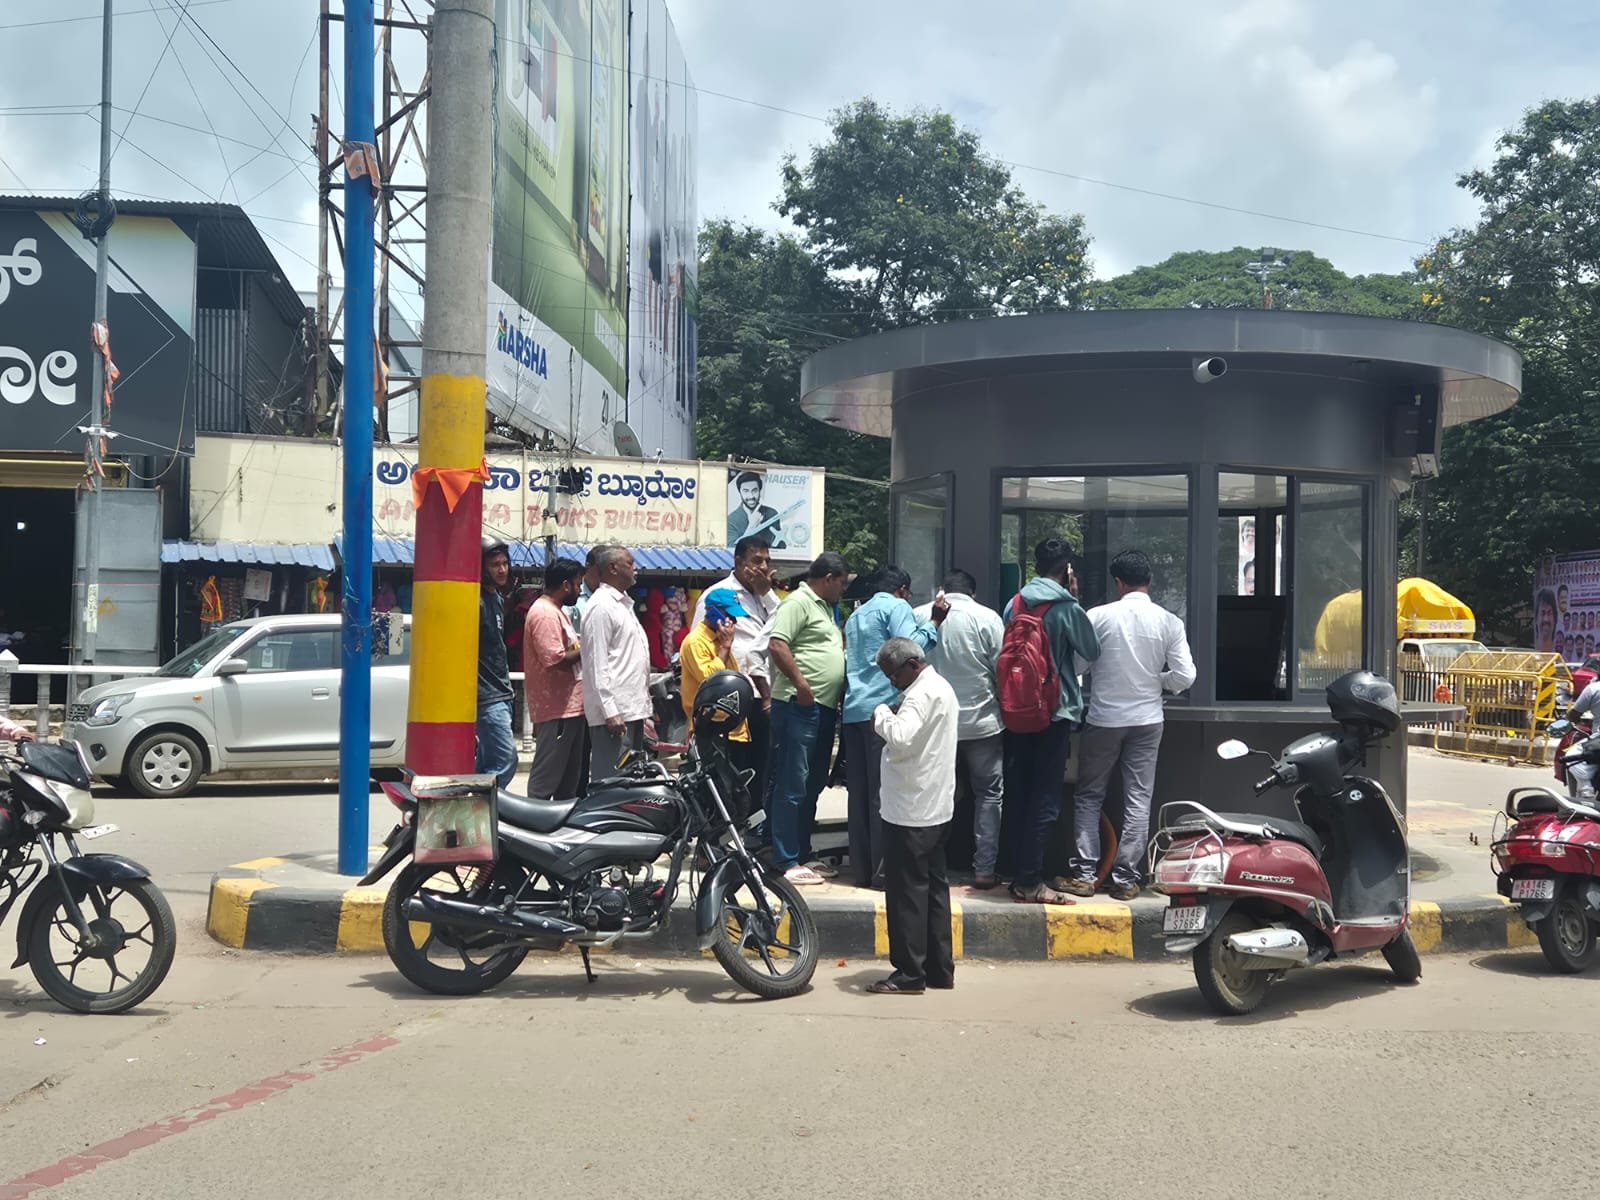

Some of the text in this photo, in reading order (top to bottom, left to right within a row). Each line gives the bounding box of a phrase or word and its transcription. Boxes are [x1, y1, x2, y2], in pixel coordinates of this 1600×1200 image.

[497, 310, 548, 380] HARSHA
[765, 474, 806, 485] HAUSER
[526, 505, 598, 528] BOKS
[604, 508, 692, 532] BUREAU
[1428, 621, 1463, 630] SMS
[1174, 907, 1201, 919] KA14E
